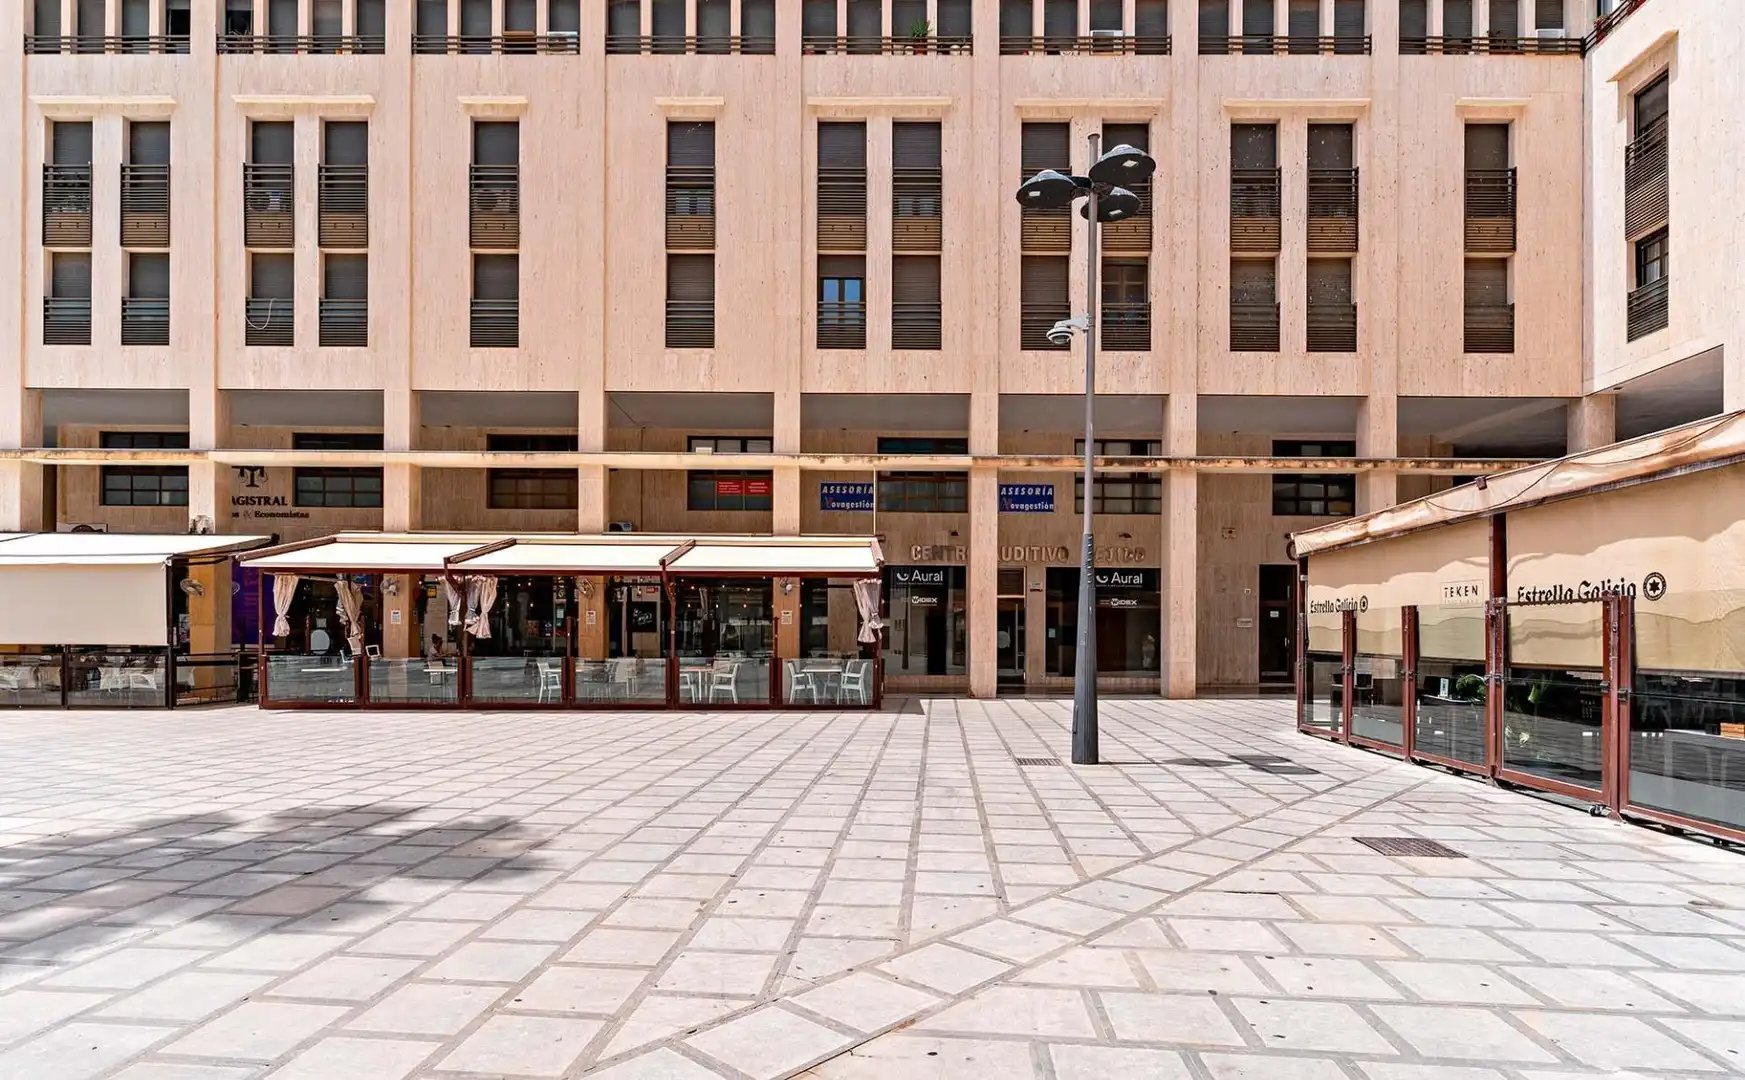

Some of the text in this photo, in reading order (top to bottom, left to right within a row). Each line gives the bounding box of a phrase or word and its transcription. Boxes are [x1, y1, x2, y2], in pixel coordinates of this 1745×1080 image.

[1001, 486, 1053, 496] ASESORÍA
[254, 510, 310, 519] Economistas
[910, 545, 970, 561] CENTR
[996, 546, 1069, 562] UDITIVO
[912, 569, 943, 582] Aural
[1111, 571, 1143, 584] Aural
[1517, 583, 1573, 606] Estrella
[1310, 601, 1334, 613] Estrella
